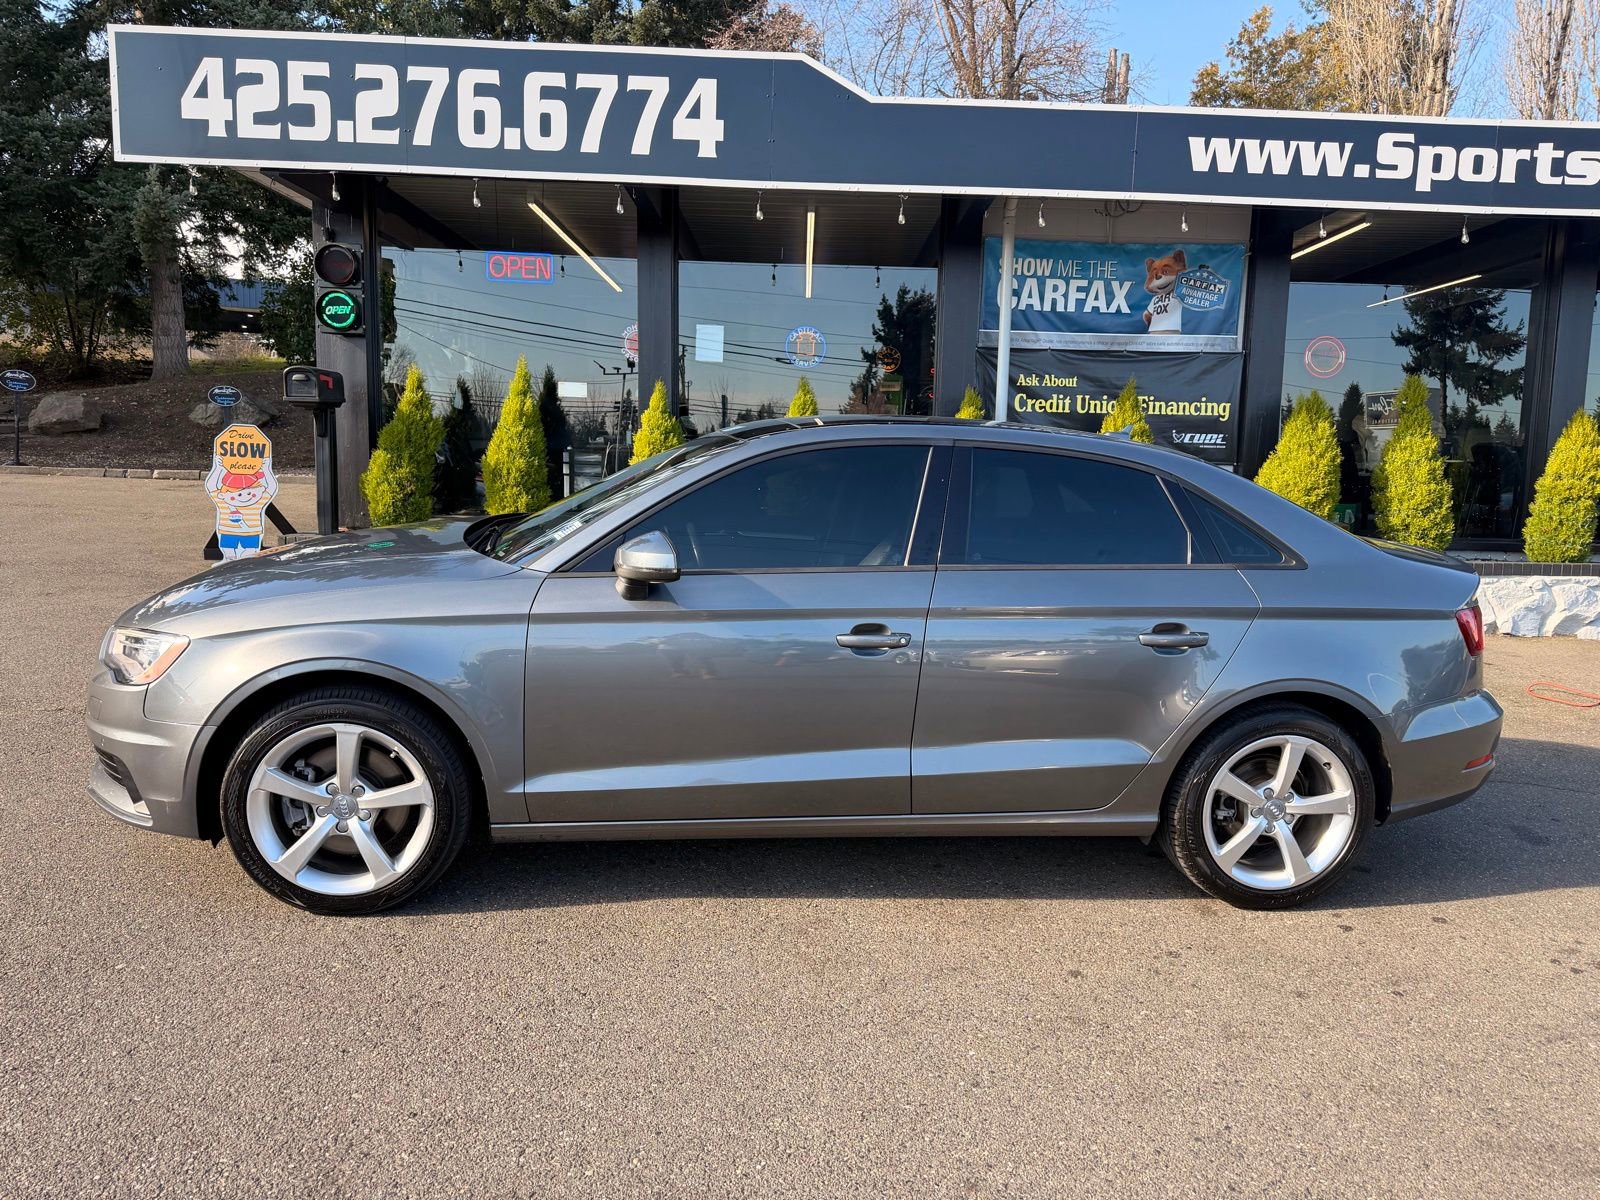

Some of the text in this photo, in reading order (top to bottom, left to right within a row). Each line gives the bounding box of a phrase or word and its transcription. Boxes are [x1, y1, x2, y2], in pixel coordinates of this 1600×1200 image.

[181, 57, 724, 158] 425.276.6774
[1188, 132, 1600, 192] www.Sports
[490, 255, 550, 279] OPEN
[999, 258, 1118, 279] HOW ME THE
[1181, 277, 1225, 294] CARFAX
[997, 278, 1133, 314] CARFAX
[1153, 292, 1171, 305] CAR
[1181, 287, 1219, 302] ADVANTAGE
[1184, 296, 1210, 308] DEALER
[325, 305, 351, 315] OPEN
[1152, 303, 1169, 316] FOX
[1016, 374, 1077, 387] Ask About
[1014, 393, 1231, 421] Credit Unio Financing
[229, 429, 254, 439] Drive
[220, 441, 266, 458] SLOW
[230, 461, 256, 471] please
